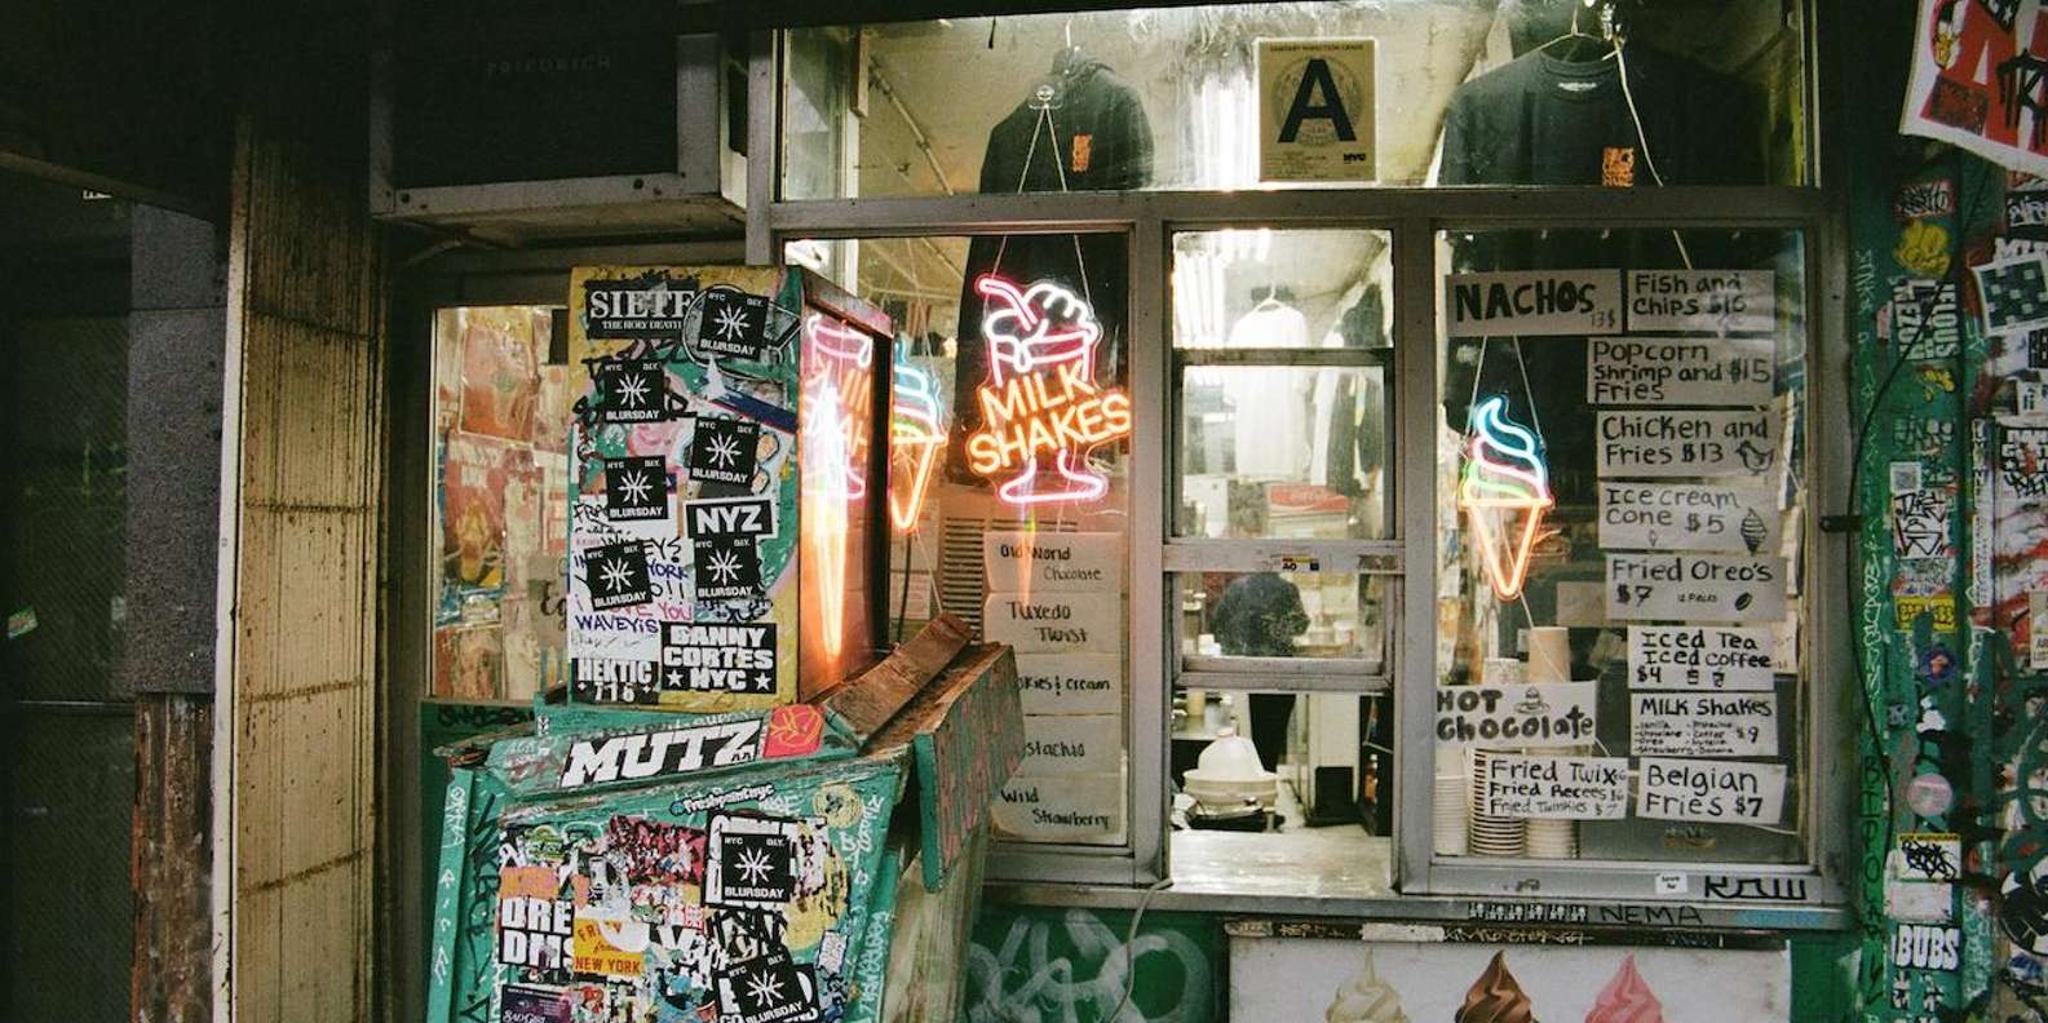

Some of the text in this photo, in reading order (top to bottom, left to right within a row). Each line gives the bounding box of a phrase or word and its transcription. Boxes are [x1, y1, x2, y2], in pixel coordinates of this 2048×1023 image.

[1277, 59, 1357, 143] A
[1635, 274, 1741, 295] Fish and
[1456, 279, 1597, 322] NACHOS
[700, 338, 755, 354] BLURSDAY
[1593, 340, 1709, 363] Popcorn
[1594, 357, 1771, 387] Shrimp and $15
[979, 360, 1096, 428] MILK
[1593, 381, 1665, 403] Fries
[606, 409, 660, 420] BLURSDAY
[969, 392, 1131, 475] SHAKES
[1602, 415, 1768, 440] Chicken and
[1606, 444, 1724, 467] Fries $13
[692, 468, 749, 483] BLURSDAY
[1606, 488, 1654, 506] Ice
[610, 507, 663, 518] BLURSDAY
[696, 504, 763, 534] NYZ
[1032, 546, 1071, 561] World
[1043, 566, 1102, 581] Chocolate
[1612, 557, 1774, 583] Fried Oreo's
[594, 592, 648, 608] BLURSDAY
[698, 586, 753, 598] BLURSDAY
[1006, 601, 1071, 620] Tuxedo
[1034, 627, 1089, 642] Twist
[1641, 629, 1758, 650] Iced Tea
[663, 646, 774, 669] CORTES
[1643, 647, 1700, 666] Iced
[578, 660, 652, 683] HEKTIC
[690, 668, 747, 690] NYC
[1437, 690, 1503, 713] HOT
[1640, 698, 1772, 717] MILK Shakes
[560, 719, 763, 788] MUTZ
[1491, 760, 1558, 781] Fried
[1569, 762, 1617, 786] Twix
[1648, 764, 1757, 797] Belgian
[1000, 787, 1040, 803] Wild
[1490, 781, 1541, 797] Fried
[1490, 798, 1532, 815] Fried
[1646, 793, 1763, 818] Fries $7
[1032, 808, 1111, 830] Strawberry
[725, 886, 785, 899] BLURSDAY
[1600, 903, 1704, 926] NEMA
[575, 956, 640, 974] NEW YORK
